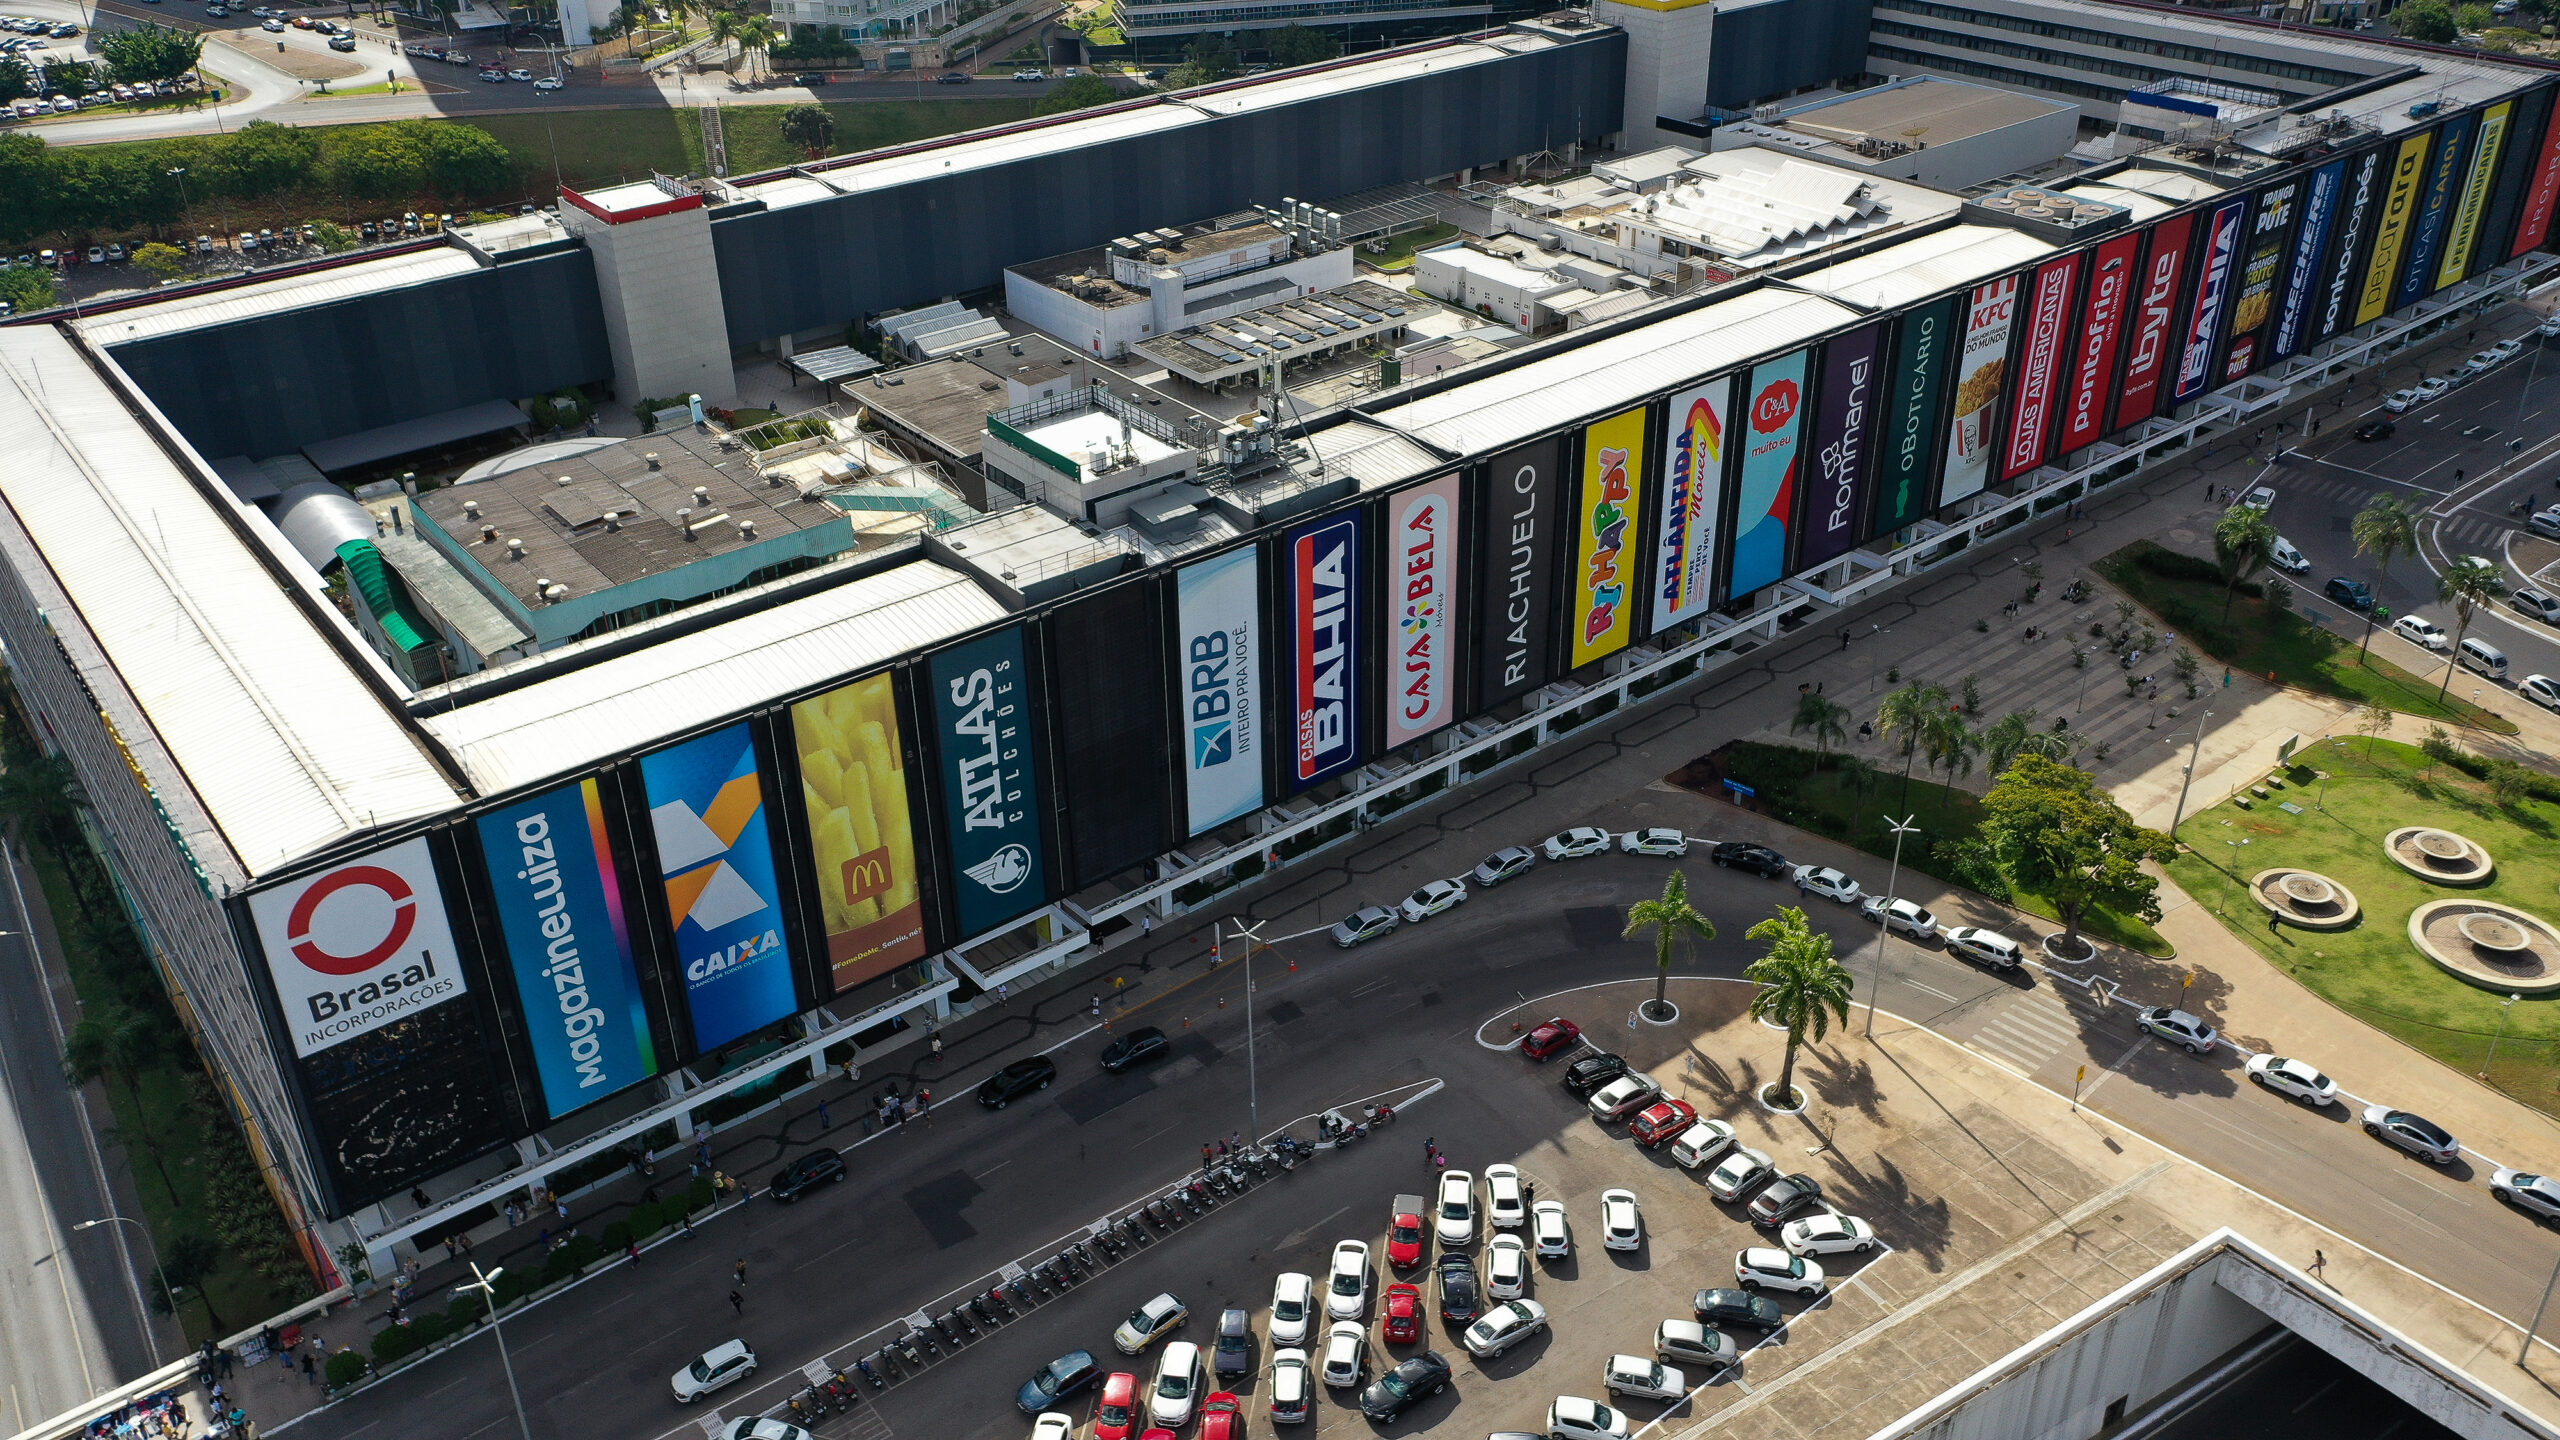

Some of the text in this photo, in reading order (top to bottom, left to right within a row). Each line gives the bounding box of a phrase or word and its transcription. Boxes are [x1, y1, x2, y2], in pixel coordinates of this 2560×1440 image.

[2262, 183, 2295, 207] FRANGO
[2452, 124, 2499, 267] PERNAMBUCANAS
[2245, 263, 2276, 287] FRITO
[2276, 171, 2328, 355] SKECHERS
[2322, 152, 2377, 335] sonhodospés
[1968, 298, 2013, 333] KFC
[2129, 250, 2177, 377] ibyte
[2185, 216, 2238, 382] BAHIA
[1965, 331, 2007, 354] DO MUNDO
[2016, 267, 2064, 468] LOJAS AMERICANAS
[2179, 343, 2195, 384] CASAS
[1759, 392, 1790, 421] C&A
[1751, 435, 1792, 458] muito eu
[1827, 355, 1869, 533] Rommanel
[1965, 455, 1976, 465] KFC
[1662, 427, 1694, 600] ATLÂNTIDA
[1504, 464, 1536, 687] RIACHUELO
[1687, 558, 1695, 596] SEMPRE
[1701, 553, 1708, 566] DE
[1405, 504, 1435, 720] CASA BELA
[1435, 591, 1445, 628] Móveis
[1190, 630, 1231, 722] BRB
[1312, 540, 1345, 757] BAHIA
[1232, 620, 1250, 754] INTEIRO PRA VOCÊ.
[950, 667, 1004, 832] ATLAS
[995, 659, 1024, 823] COLCHÕES
[1301, 708, 1313, 762] CASAS
[306, 949, 437, 1023] Brasal
[687, 929, 781, 981] CAIXA
[695, 976, 716, 988] BANCO
[724, 965, 742, 976] TODOS
[304, 977, 454, 1046] INCORPORAÇÕES
